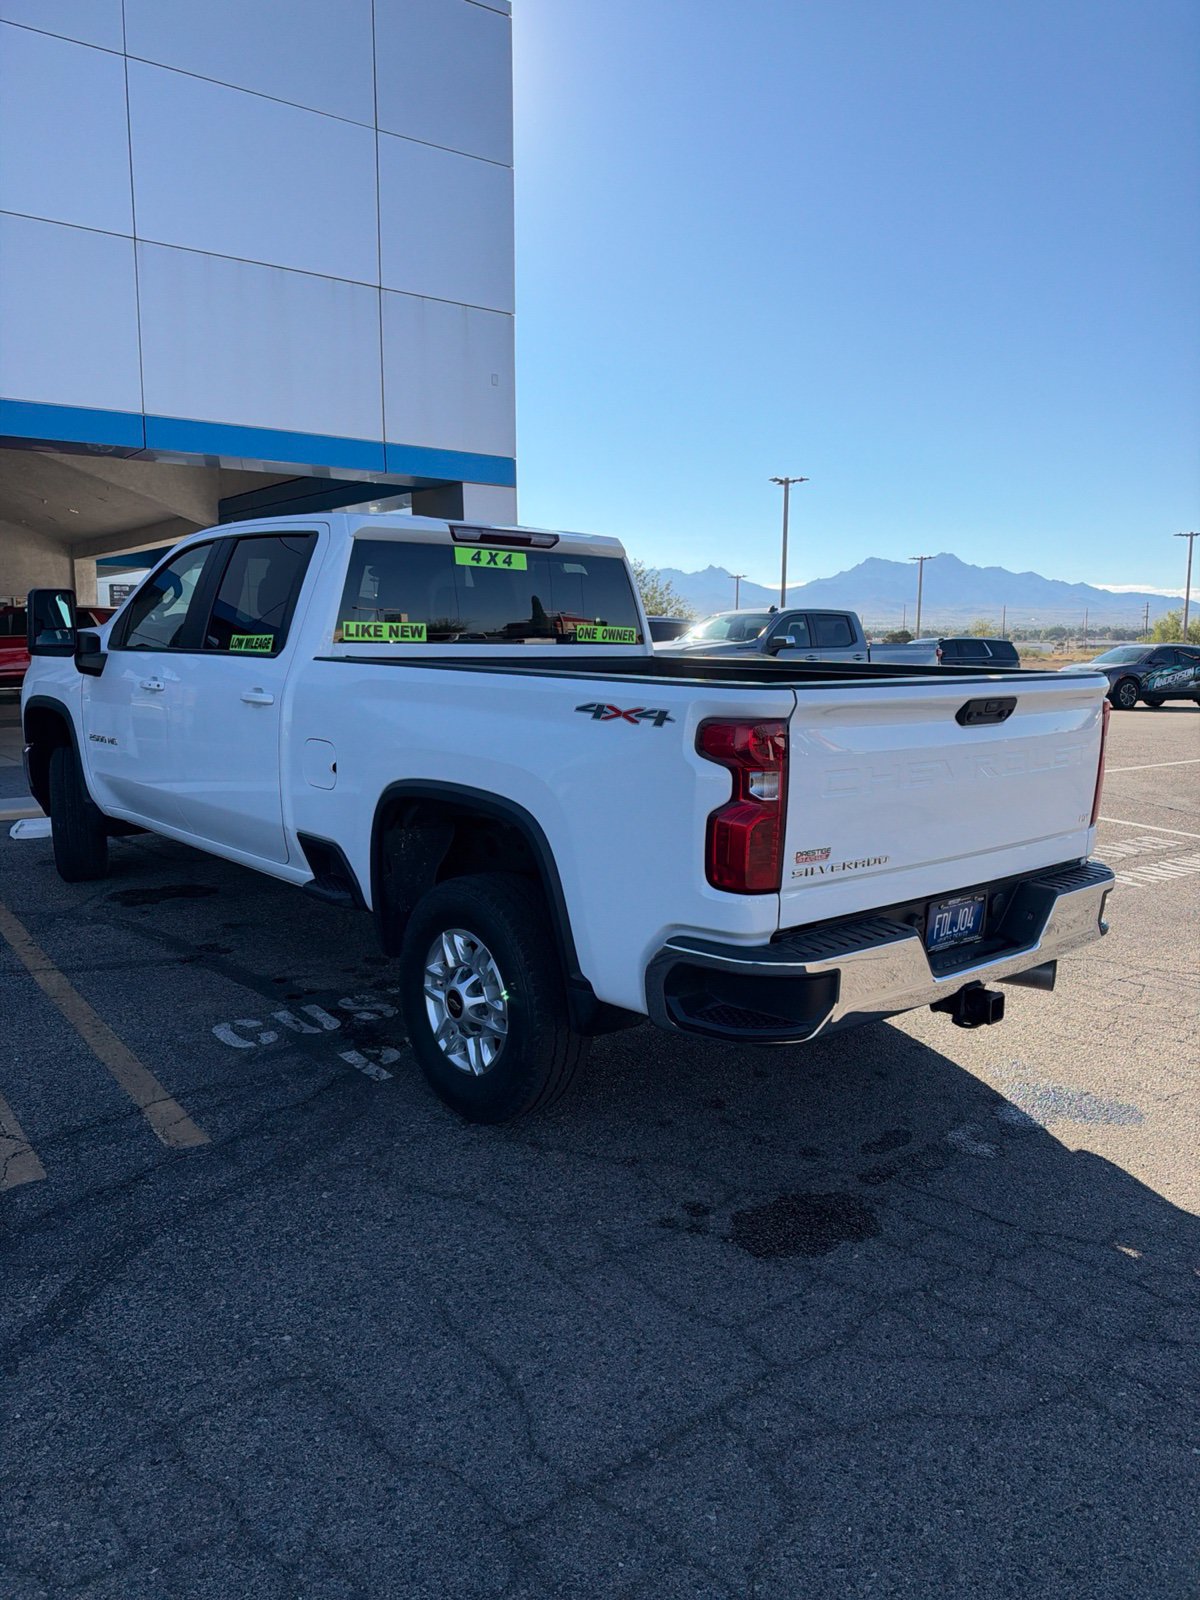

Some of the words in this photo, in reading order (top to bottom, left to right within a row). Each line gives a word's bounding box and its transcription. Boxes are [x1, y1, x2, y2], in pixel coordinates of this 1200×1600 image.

[344, 623, 384, 639] LIKE
[388, 625, 425, 639] NEW
[577, 628, 598, 641] ONE
[601, 629, 635, 643] OWNER
[231, 637, 244, 648] LOW
[244, 637, 272, 649] MILEAGE
[1154, 667, 1194, 688] ANDERSON
[791, 855, 890, 879] SILVERADO
